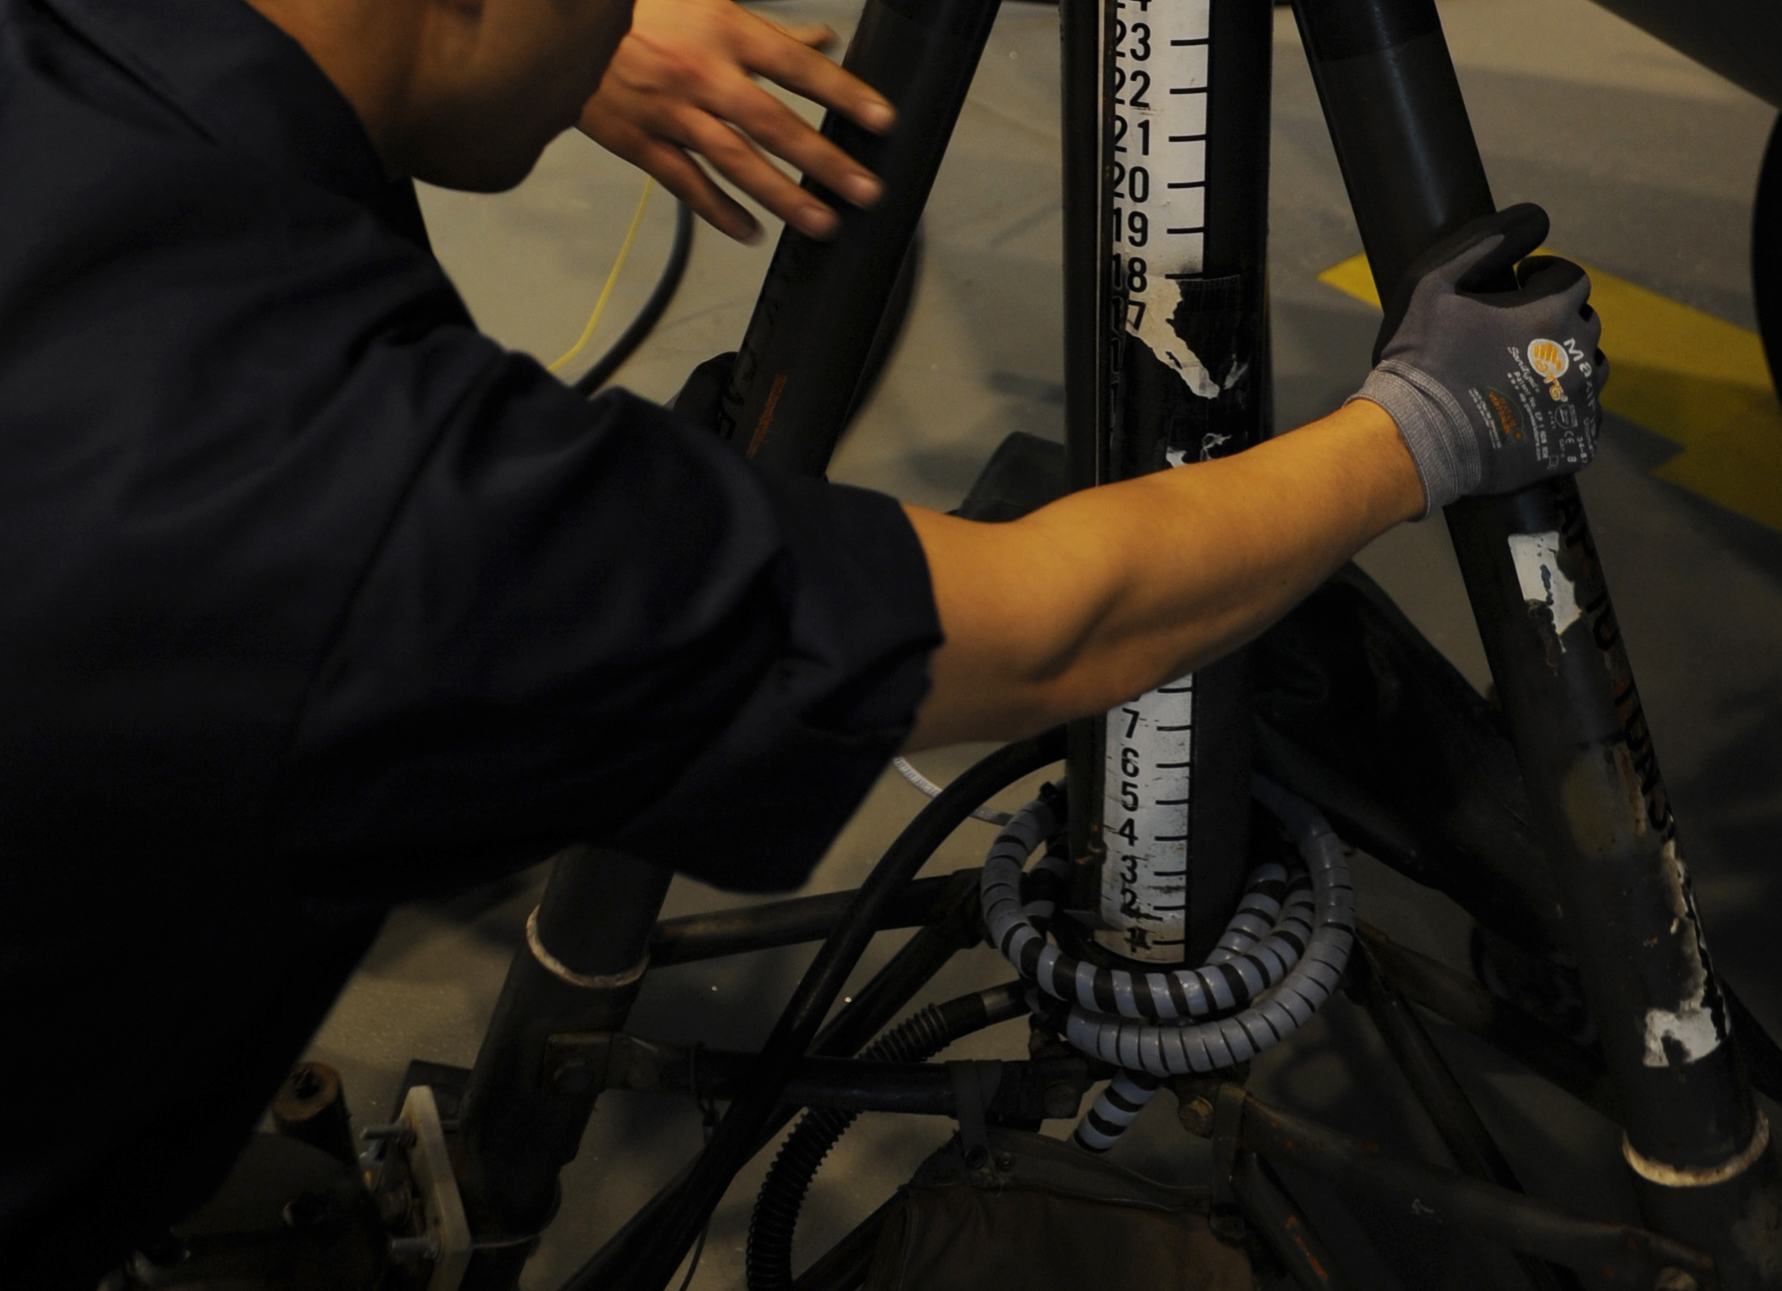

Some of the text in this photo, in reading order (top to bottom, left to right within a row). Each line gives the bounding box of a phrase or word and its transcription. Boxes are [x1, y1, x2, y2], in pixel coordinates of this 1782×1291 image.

[1116, 19, 1151, 61] 23
[1114, 66, 1150, 108] 22
[1114, 115, 1150, 156] 21
[1113, 161, 1148, 203] 20
[1113, 208, 1148, 247] 19
[1112, 253, 1147, 293] 18
[1122, 707, 1139, 738] 7
[1121, 748, 1139, 778] 6
[1121, 782, 1139, 811] 5
[1119, 818, 1138, 846] 4
[1121, 856, 1137, 884] 3
